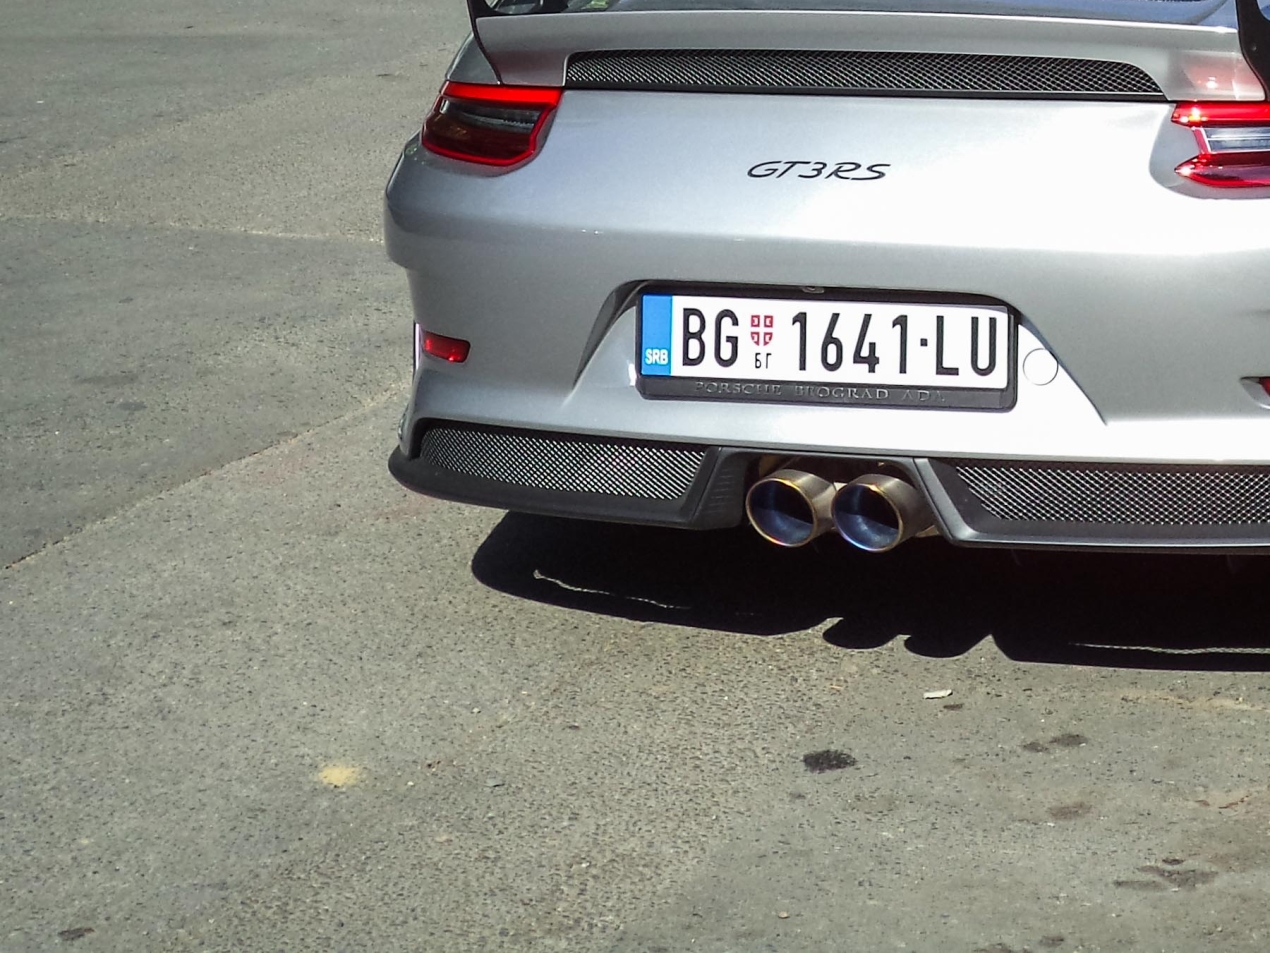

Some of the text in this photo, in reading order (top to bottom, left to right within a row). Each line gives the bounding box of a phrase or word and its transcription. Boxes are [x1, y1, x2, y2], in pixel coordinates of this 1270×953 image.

[682, 307, 740, 368] BG
[645, 348, 669, 365] SRB
[694, 381, 782, 396] PORSCHE
